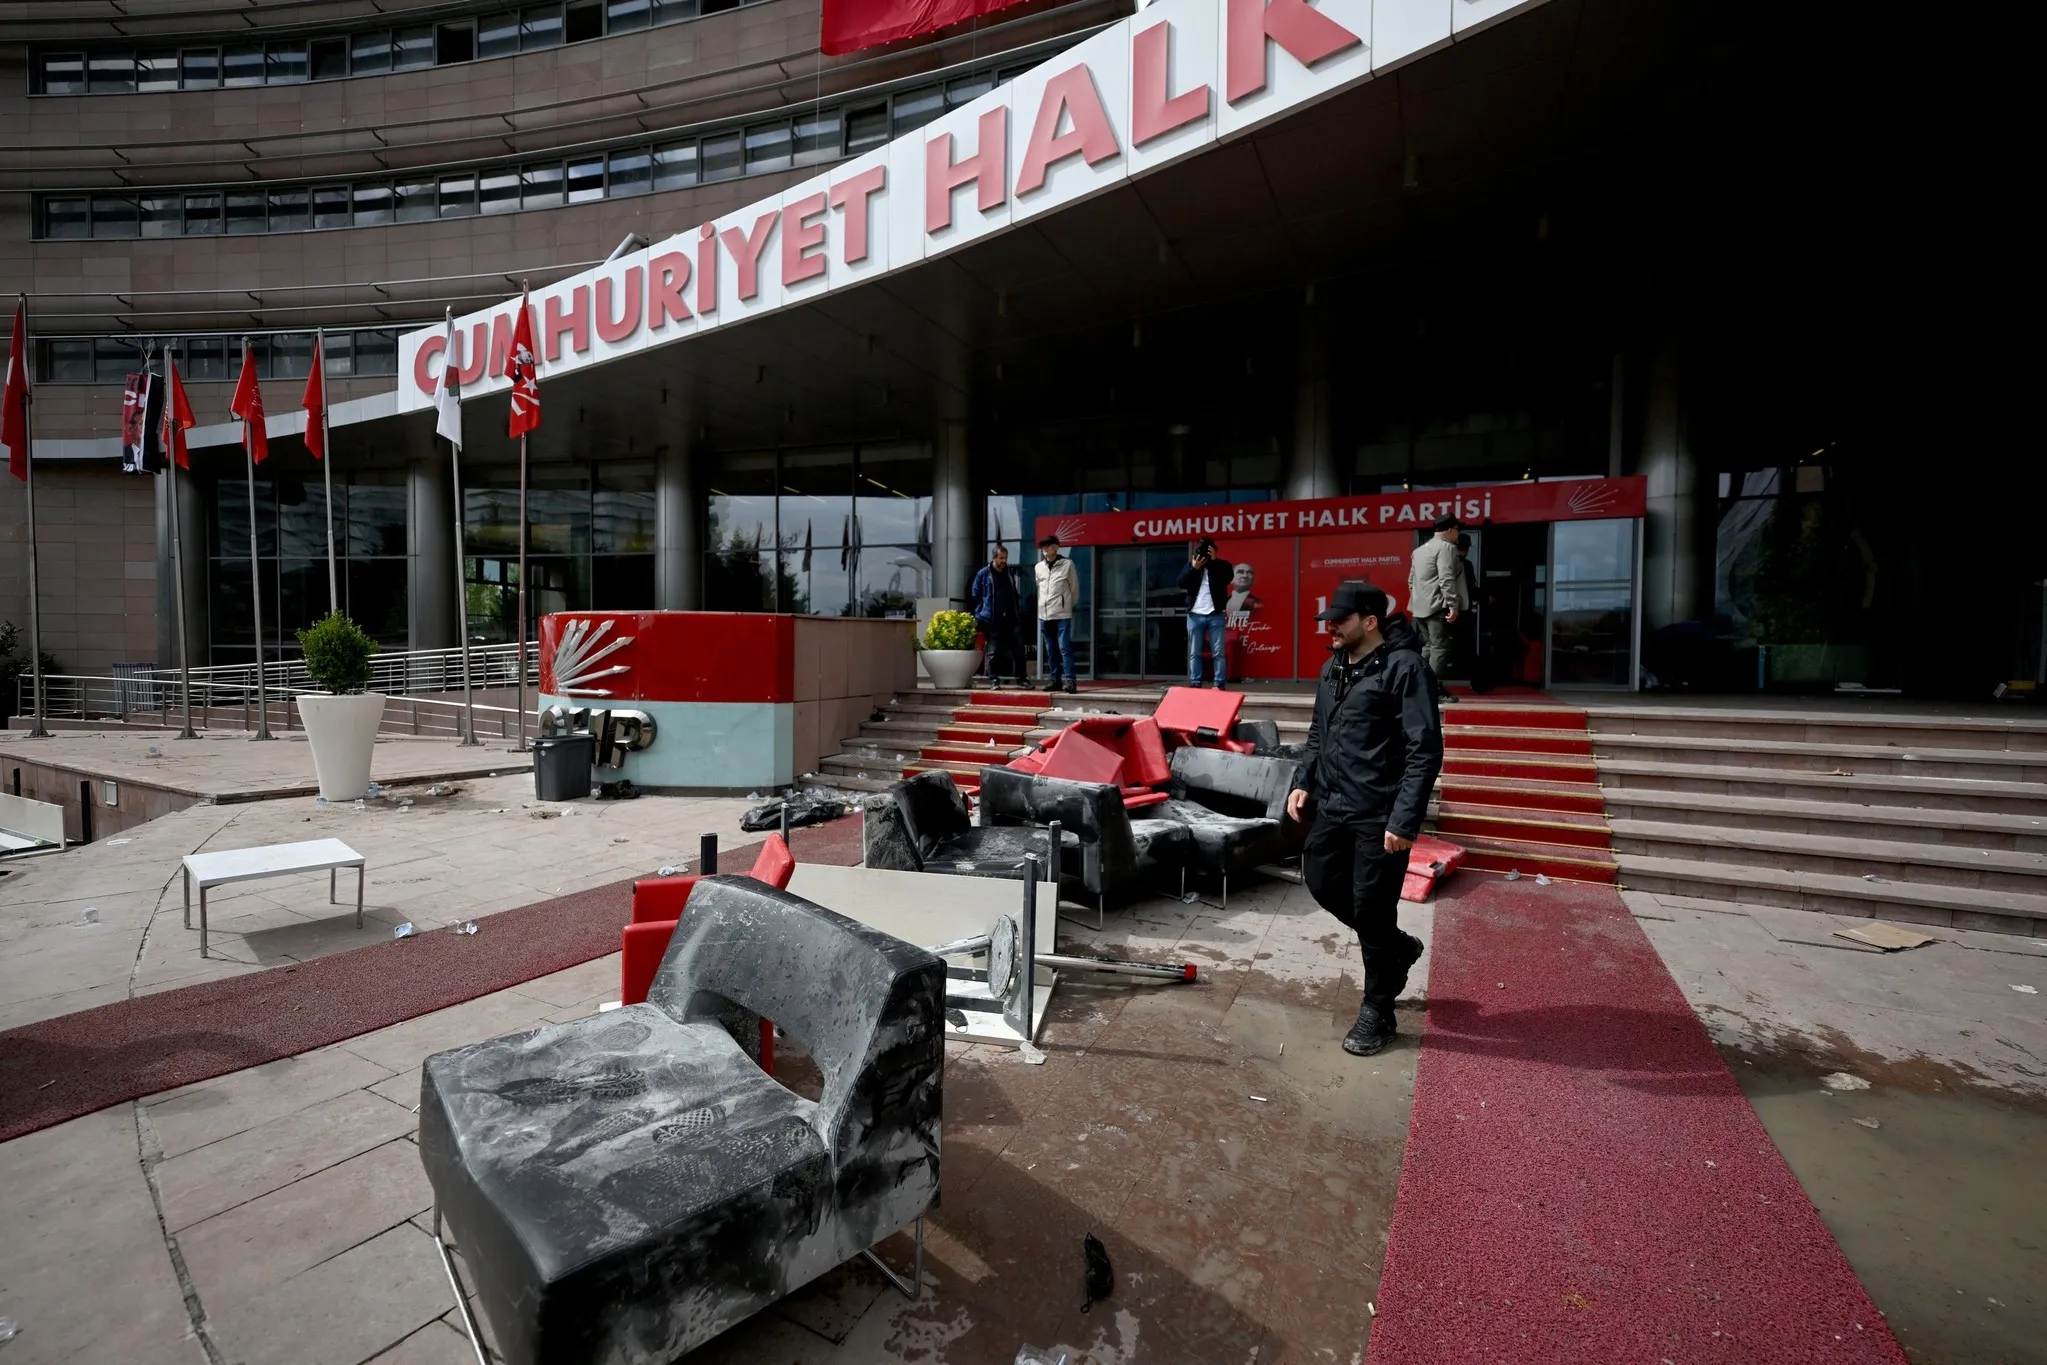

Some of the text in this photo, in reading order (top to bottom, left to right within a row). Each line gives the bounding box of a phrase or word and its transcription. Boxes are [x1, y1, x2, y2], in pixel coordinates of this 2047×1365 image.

[414, 0, 1362, 395] CUMHURİYET HALK
[1133, 492, 1491, 538] CUMHURİYET HALK PARTİSİ
